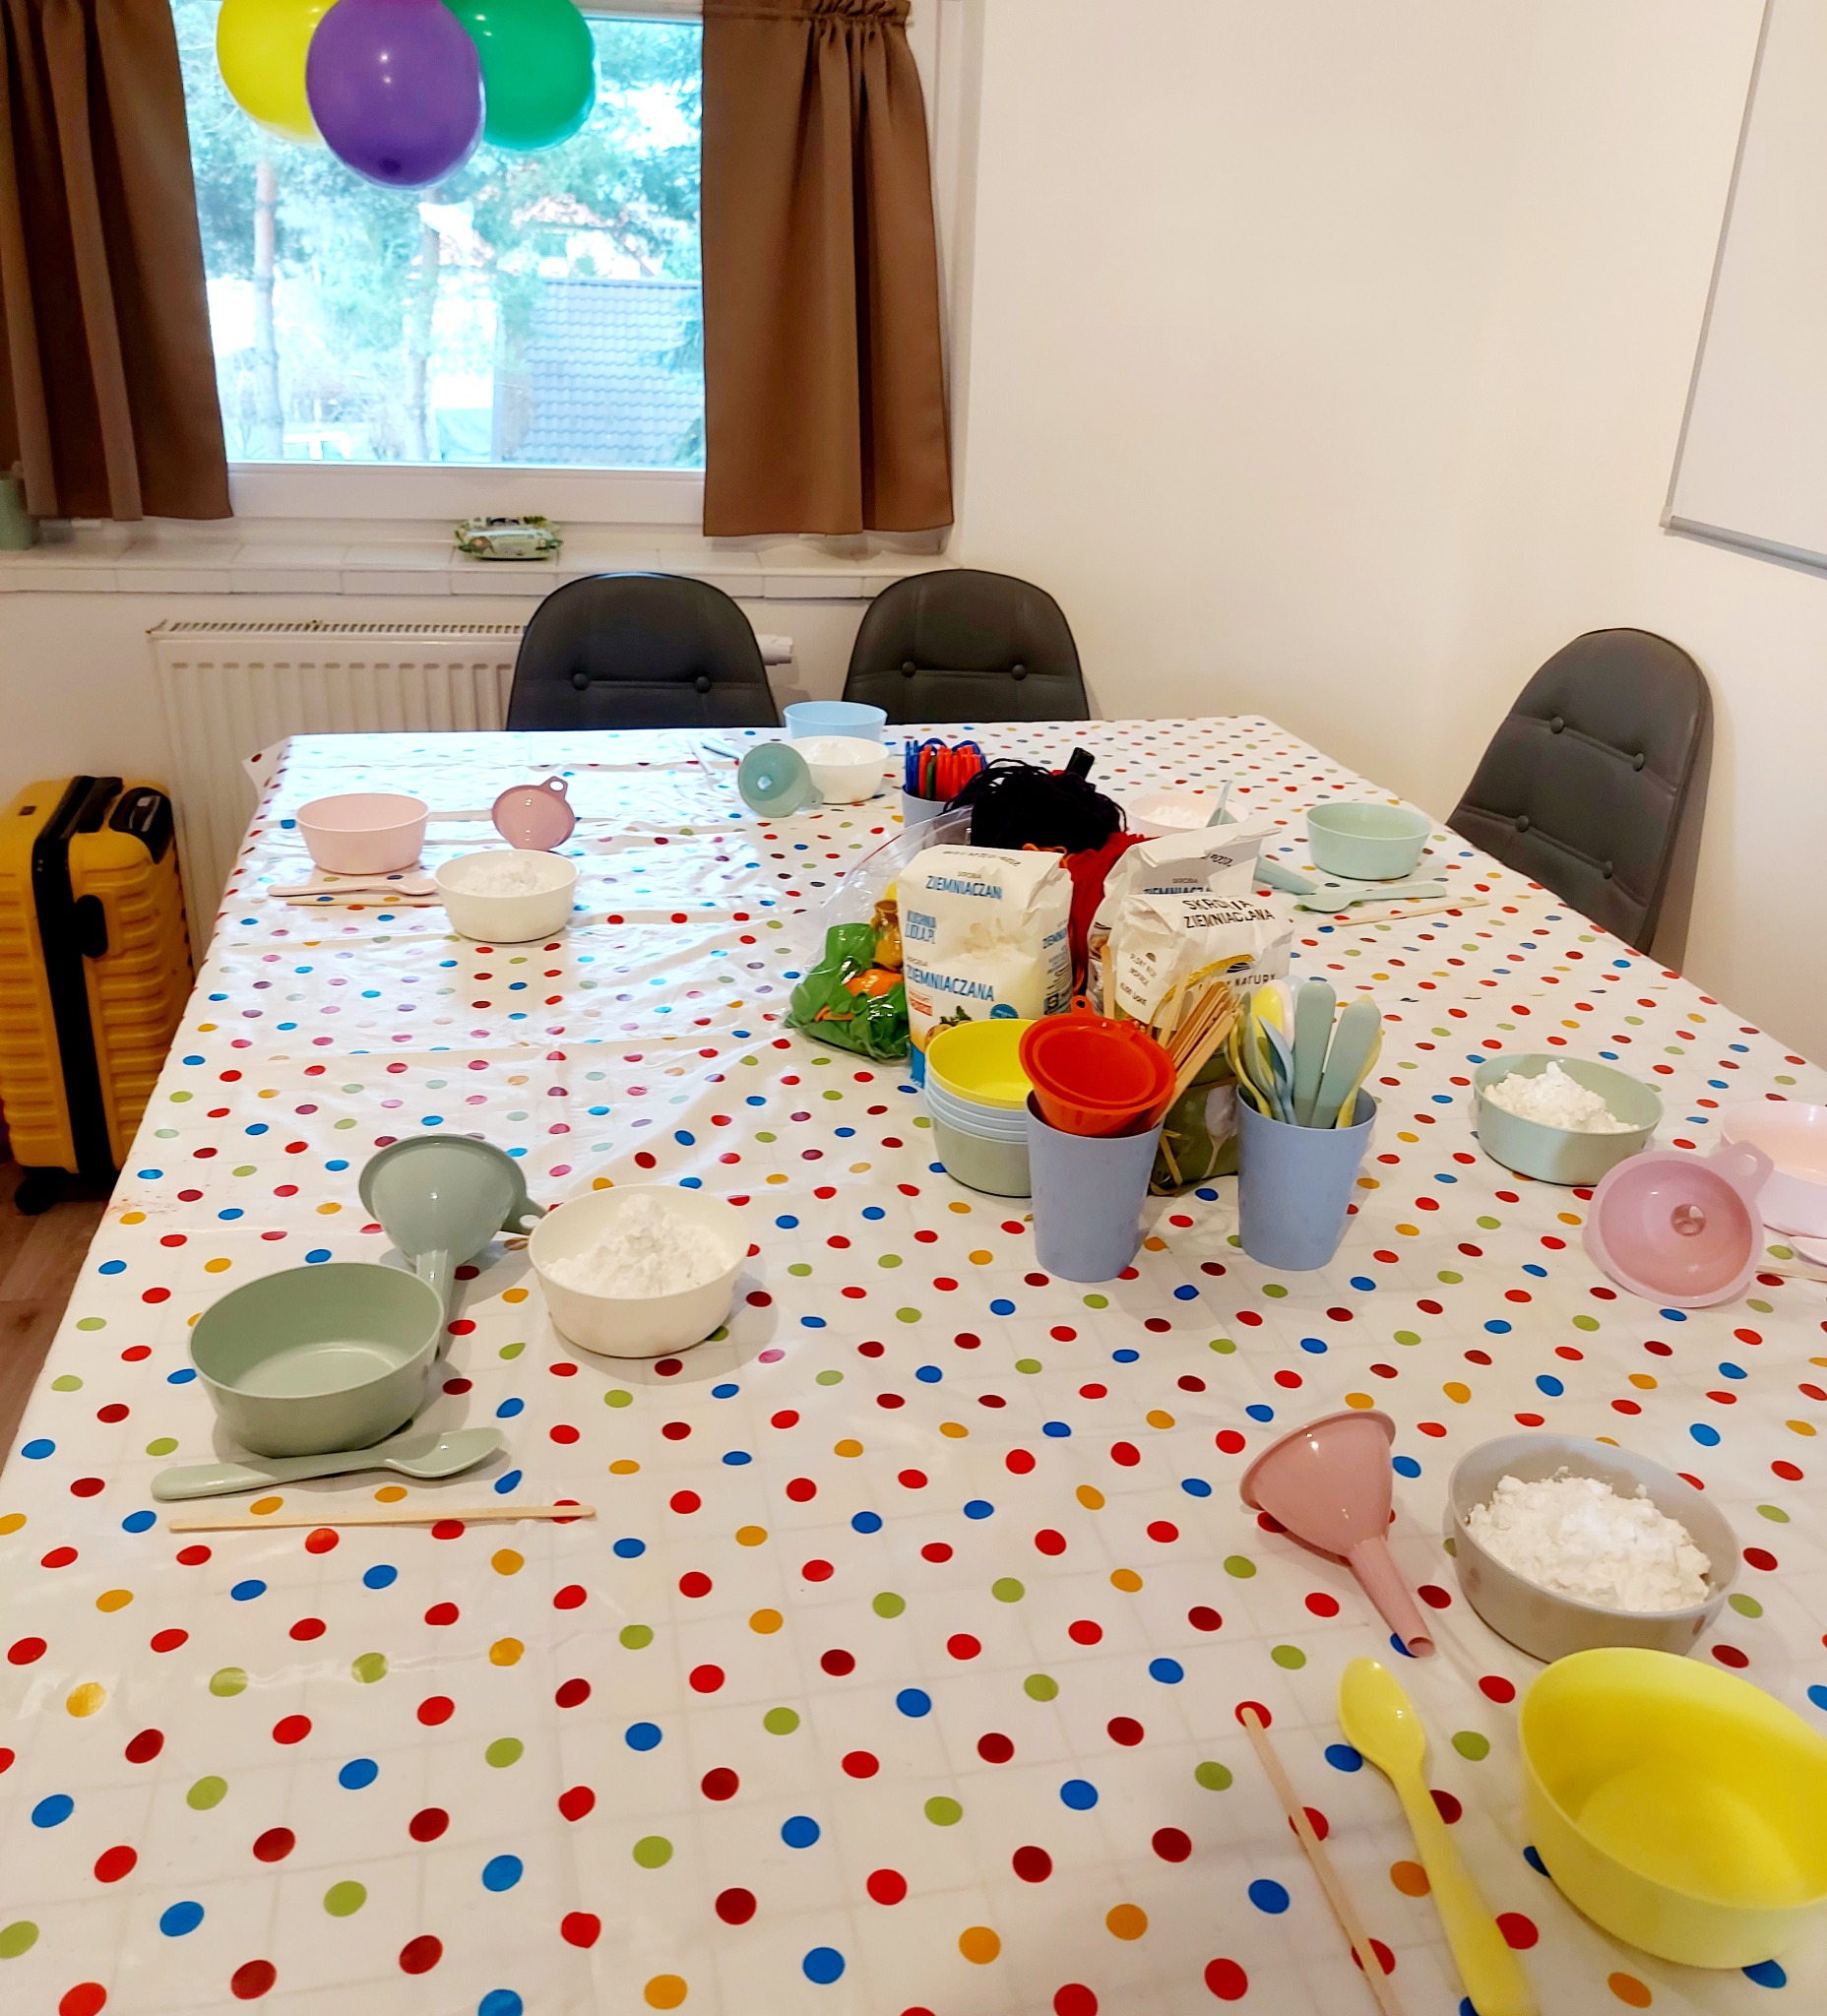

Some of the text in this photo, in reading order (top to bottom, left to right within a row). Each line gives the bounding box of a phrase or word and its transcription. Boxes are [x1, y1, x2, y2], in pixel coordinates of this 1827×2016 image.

[1182, 899, 1254, 912] SKROIA
[906, 964, 995, 1002] ZIEMNIACZANA
[1233, 973, 1277, 987] NATURY
